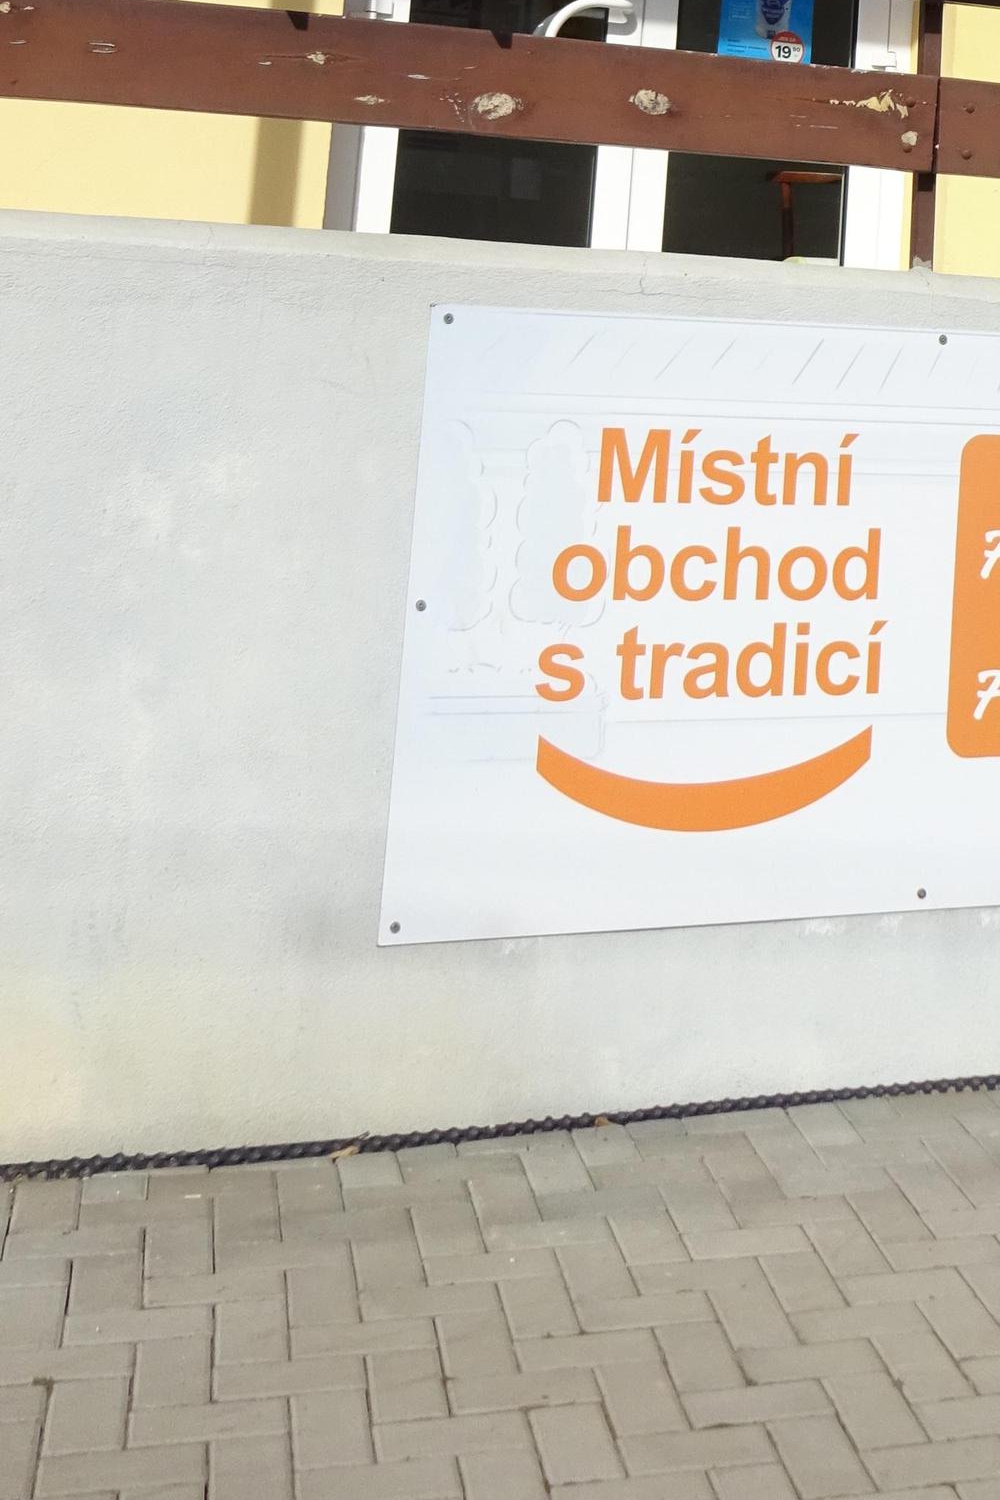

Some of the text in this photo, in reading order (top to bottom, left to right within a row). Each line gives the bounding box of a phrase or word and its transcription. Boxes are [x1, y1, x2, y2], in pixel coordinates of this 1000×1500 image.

[775, 45, 792, 59] 19
[597, 427, 860, 506] Místní
[552, 524, 882, 602] obchod
[534, 619, 889, 702] s tradicí
